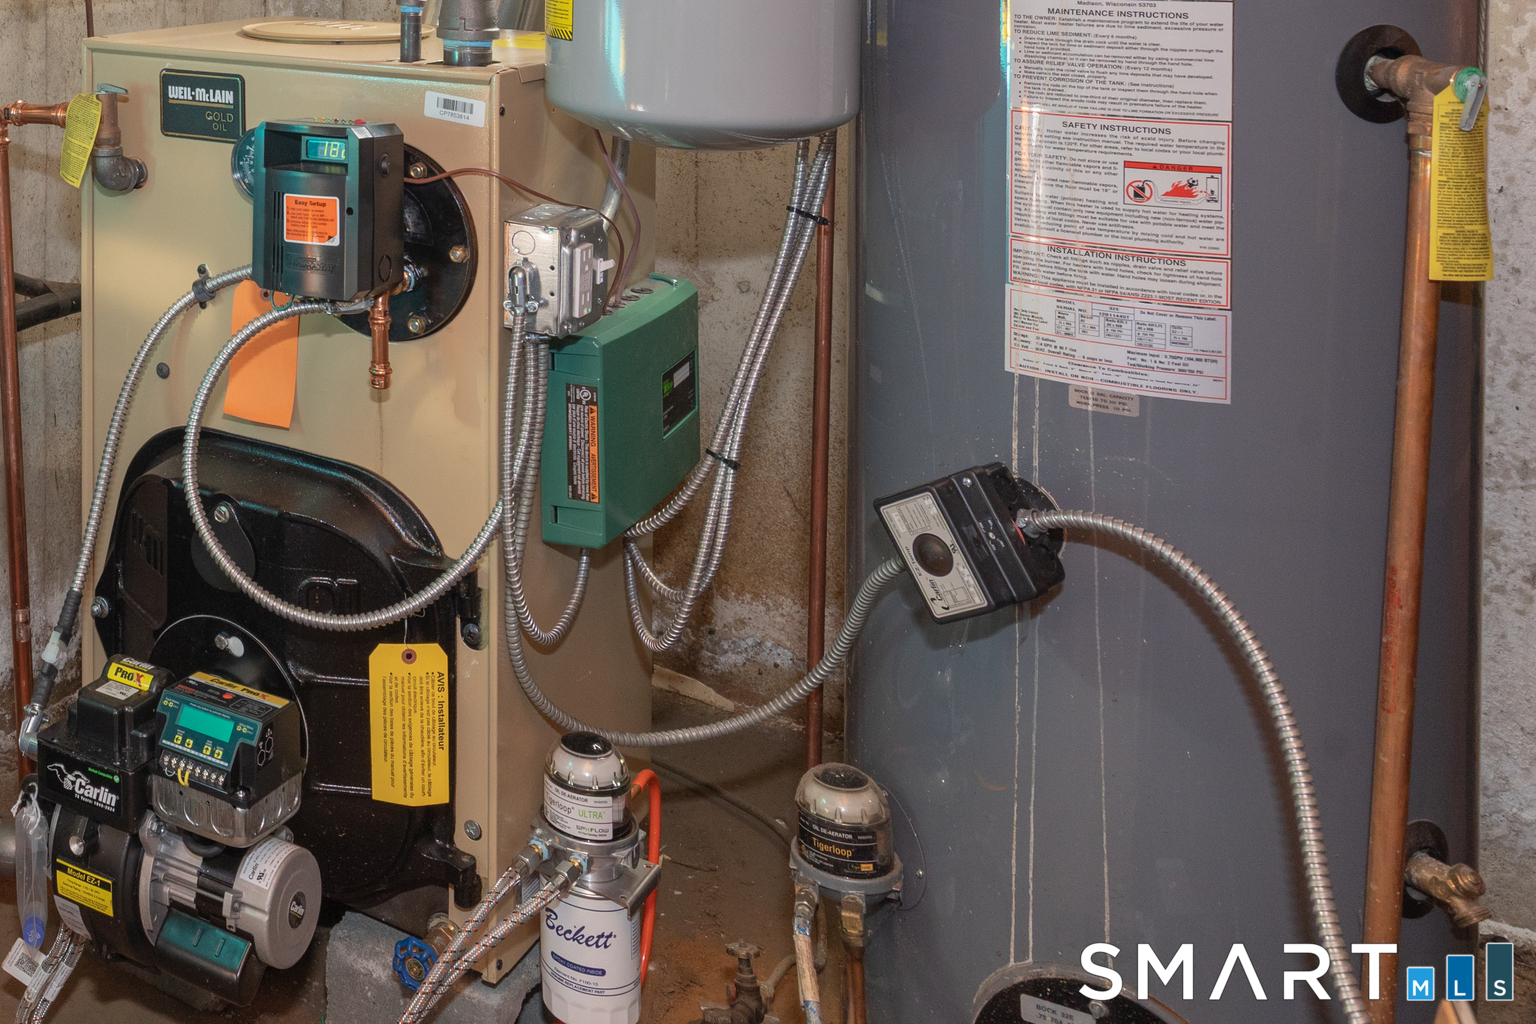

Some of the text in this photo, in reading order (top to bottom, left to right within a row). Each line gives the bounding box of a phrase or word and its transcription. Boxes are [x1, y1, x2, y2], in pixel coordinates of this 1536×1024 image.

[1047, 8, 1189, 19] MAINTENANCE INSTRUCTIONS
[206, 111, 234, 122] GOLD
[212, 122, 227, 132] OIL
[1062, 121, 1172, 135] SAFETY INSTRUCTIONS
[294, 199, 308, 208] Easy
[1047, 246, 1187, 267] INSTALLATION INSTRUCTIONS
[929, 579, 942, 601] Carlin
[122, 657, 155, 670] Carlin
[437, 700, 445, 751] Installateur
[74, 778, 117, 807] Carlin
[578, 809, 604, 820] ULTRA
[821, 828, 853, 840] DE-AERATOR
[812, 836, 852, 858] Tigerloop
[67, 867, 101, 887] Model EZ-1
[249, 863, 259, 880] Carlin
[290, 901, 304, 916] Carlin
[545, 907, 614, 949] Beckett
[566, 961, 586, 973] COATED
[1036, 1004, 1074, 1021] BOCK 32E
